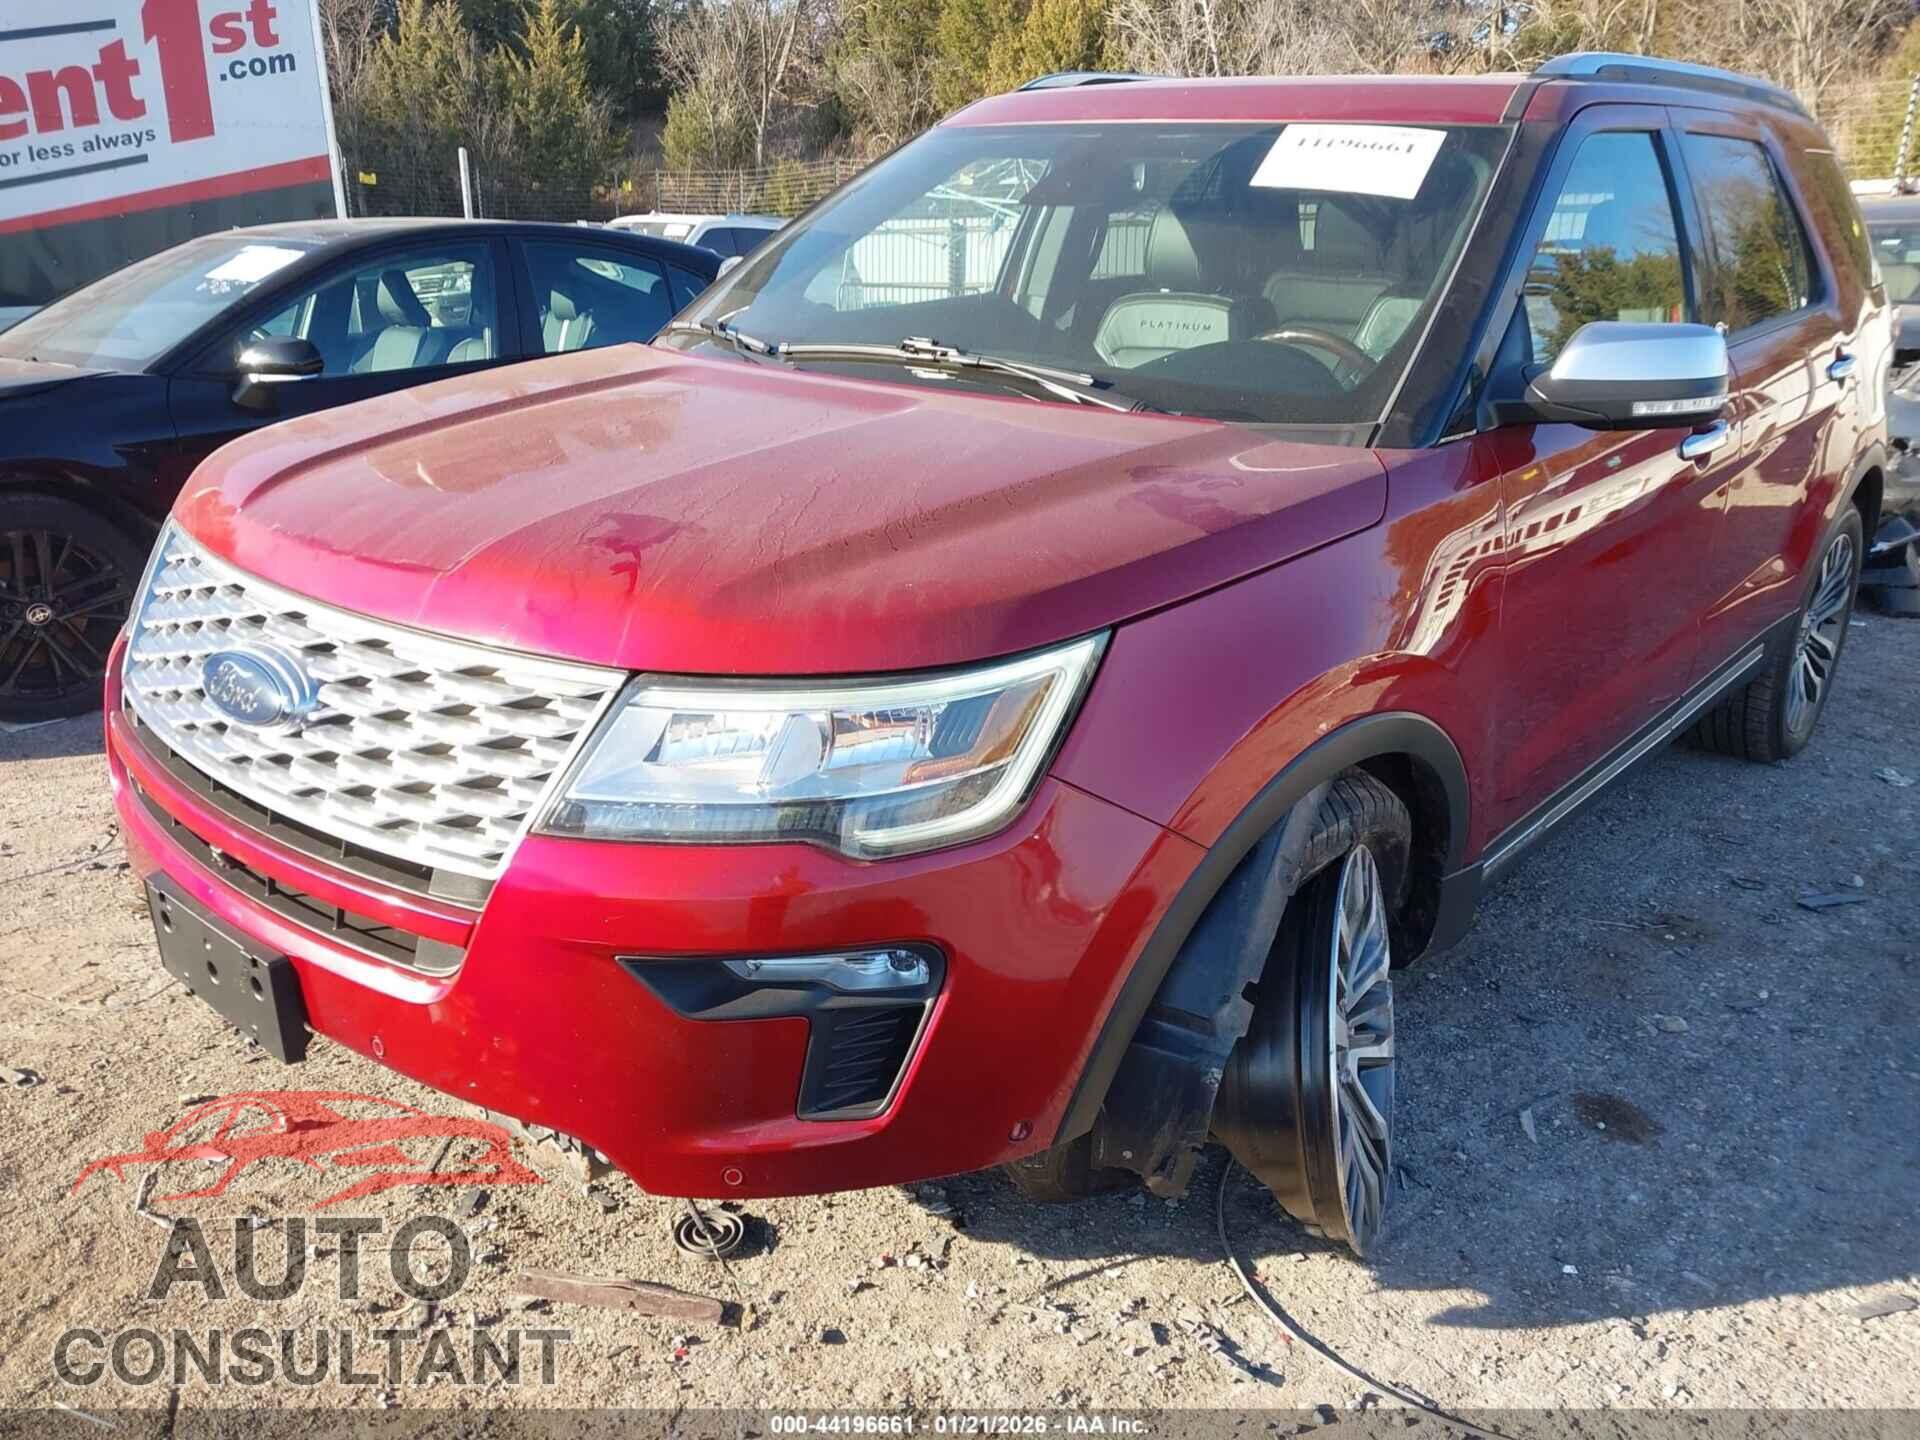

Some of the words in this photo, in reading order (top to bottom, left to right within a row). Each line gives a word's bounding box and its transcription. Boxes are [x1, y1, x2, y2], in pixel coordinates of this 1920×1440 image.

[219, 52, 296, 81] .com
[27, 142, 75, 163] less
[82, 128, 156, 153] always
[1140, 319, 1211, 332] PLATINUM
[209, 660, 262, 713] Ford
